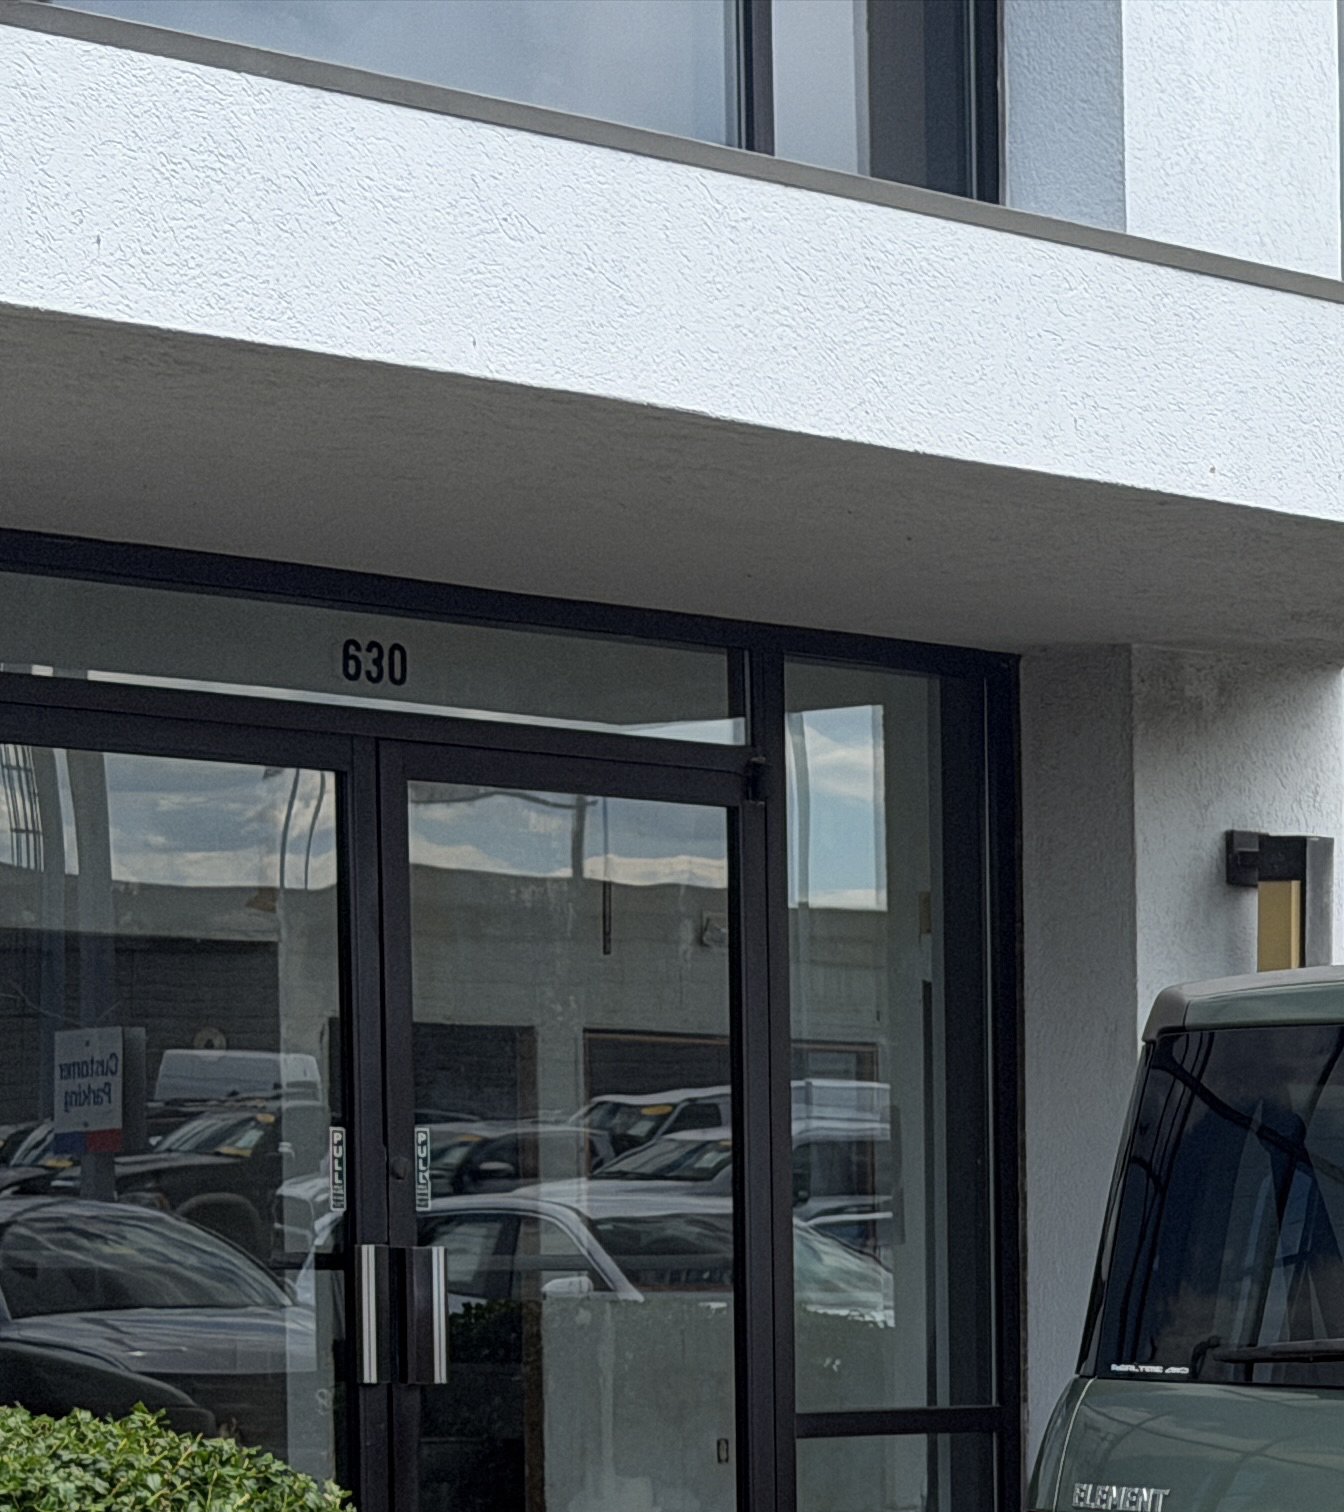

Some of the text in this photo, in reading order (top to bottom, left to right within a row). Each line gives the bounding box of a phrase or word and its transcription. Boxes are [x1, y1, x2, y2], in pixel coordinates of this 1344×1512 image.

[342, 638, 407, 686] 630
[333, 1132, 343, 1184] PULL
[417, 1132, 427, 1184] PULL
